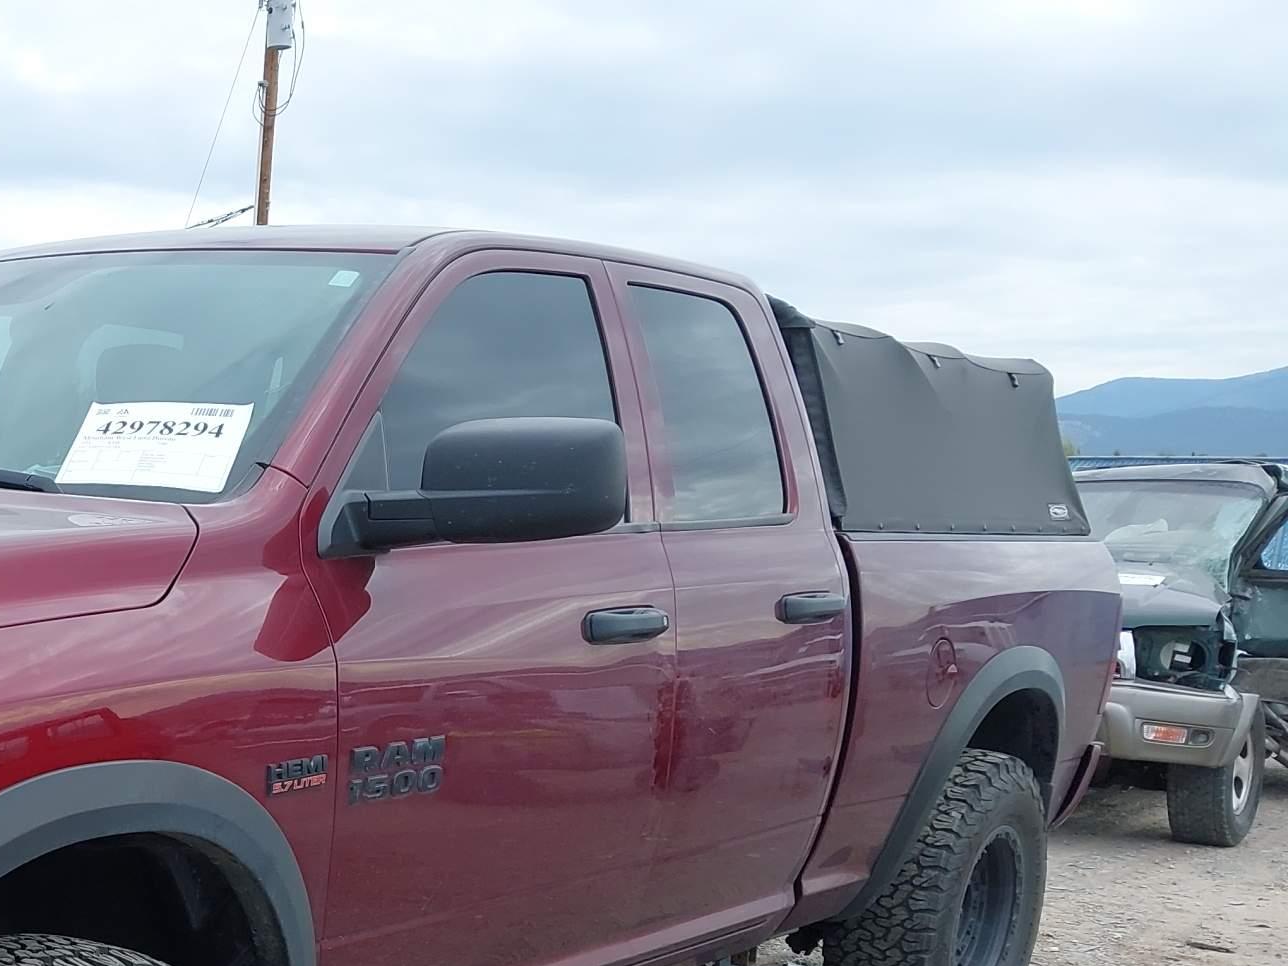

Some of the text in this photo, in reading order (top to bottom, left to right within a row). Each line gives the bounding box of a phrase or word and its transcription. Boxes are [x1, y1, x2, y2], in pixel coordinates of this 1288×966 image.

[96, 420, 225, 438] 42978294
[266, 754, 329, 782] HEMI
[350, 734, 446, 775] RAM
[272, 773, 327, 794] 5.7 LITER
[348, 764, 444, 806] 1500
